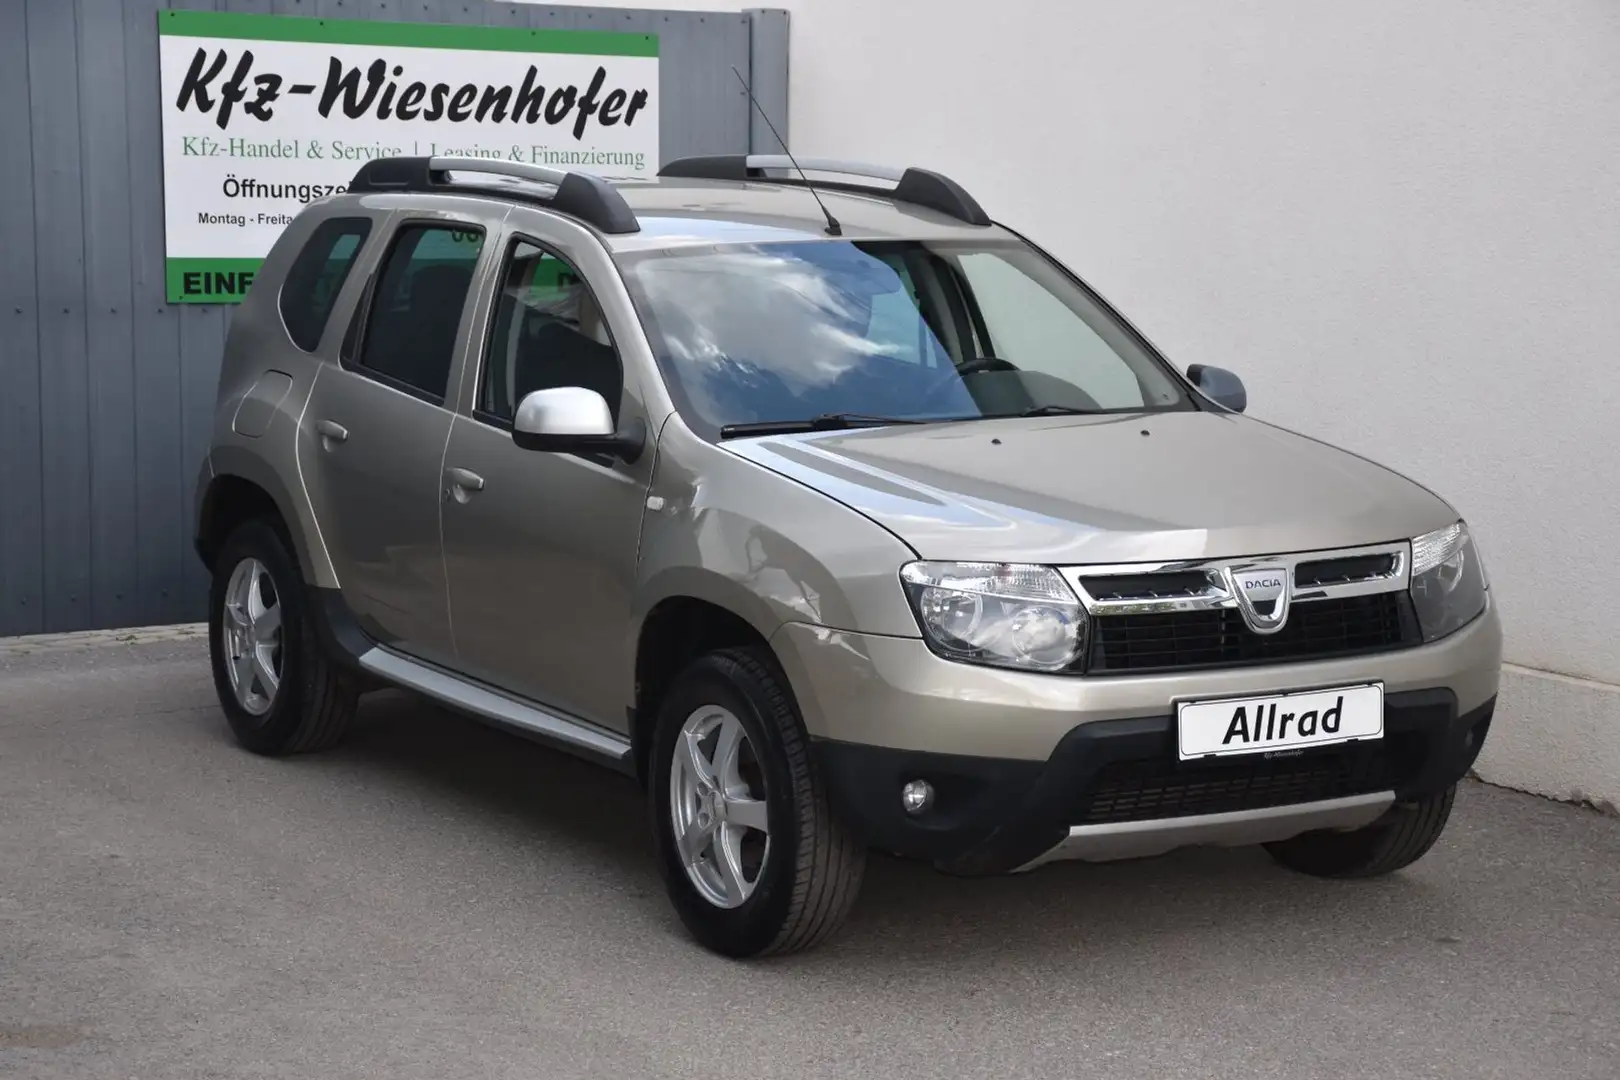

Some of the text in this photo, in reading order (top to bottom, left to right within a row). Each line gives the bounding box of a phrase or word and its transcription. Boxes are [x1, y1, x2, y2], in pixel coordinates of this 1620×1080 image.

[176, 47, 649, 140] Kfz-Wiesenhofer
[182, 136, 299, 159] Kfz-Handel
[307, 140, 324, 159] &
[331, 141, 402, 160] Service
[508, 144, 525, 162] &
[531, 145, 645, 170] Finanzierung
[198, 212, 246, 226] Montag
[1245, 579, 1281, 589] DACIA
[1222, 696, 1344, 745] Allrad
